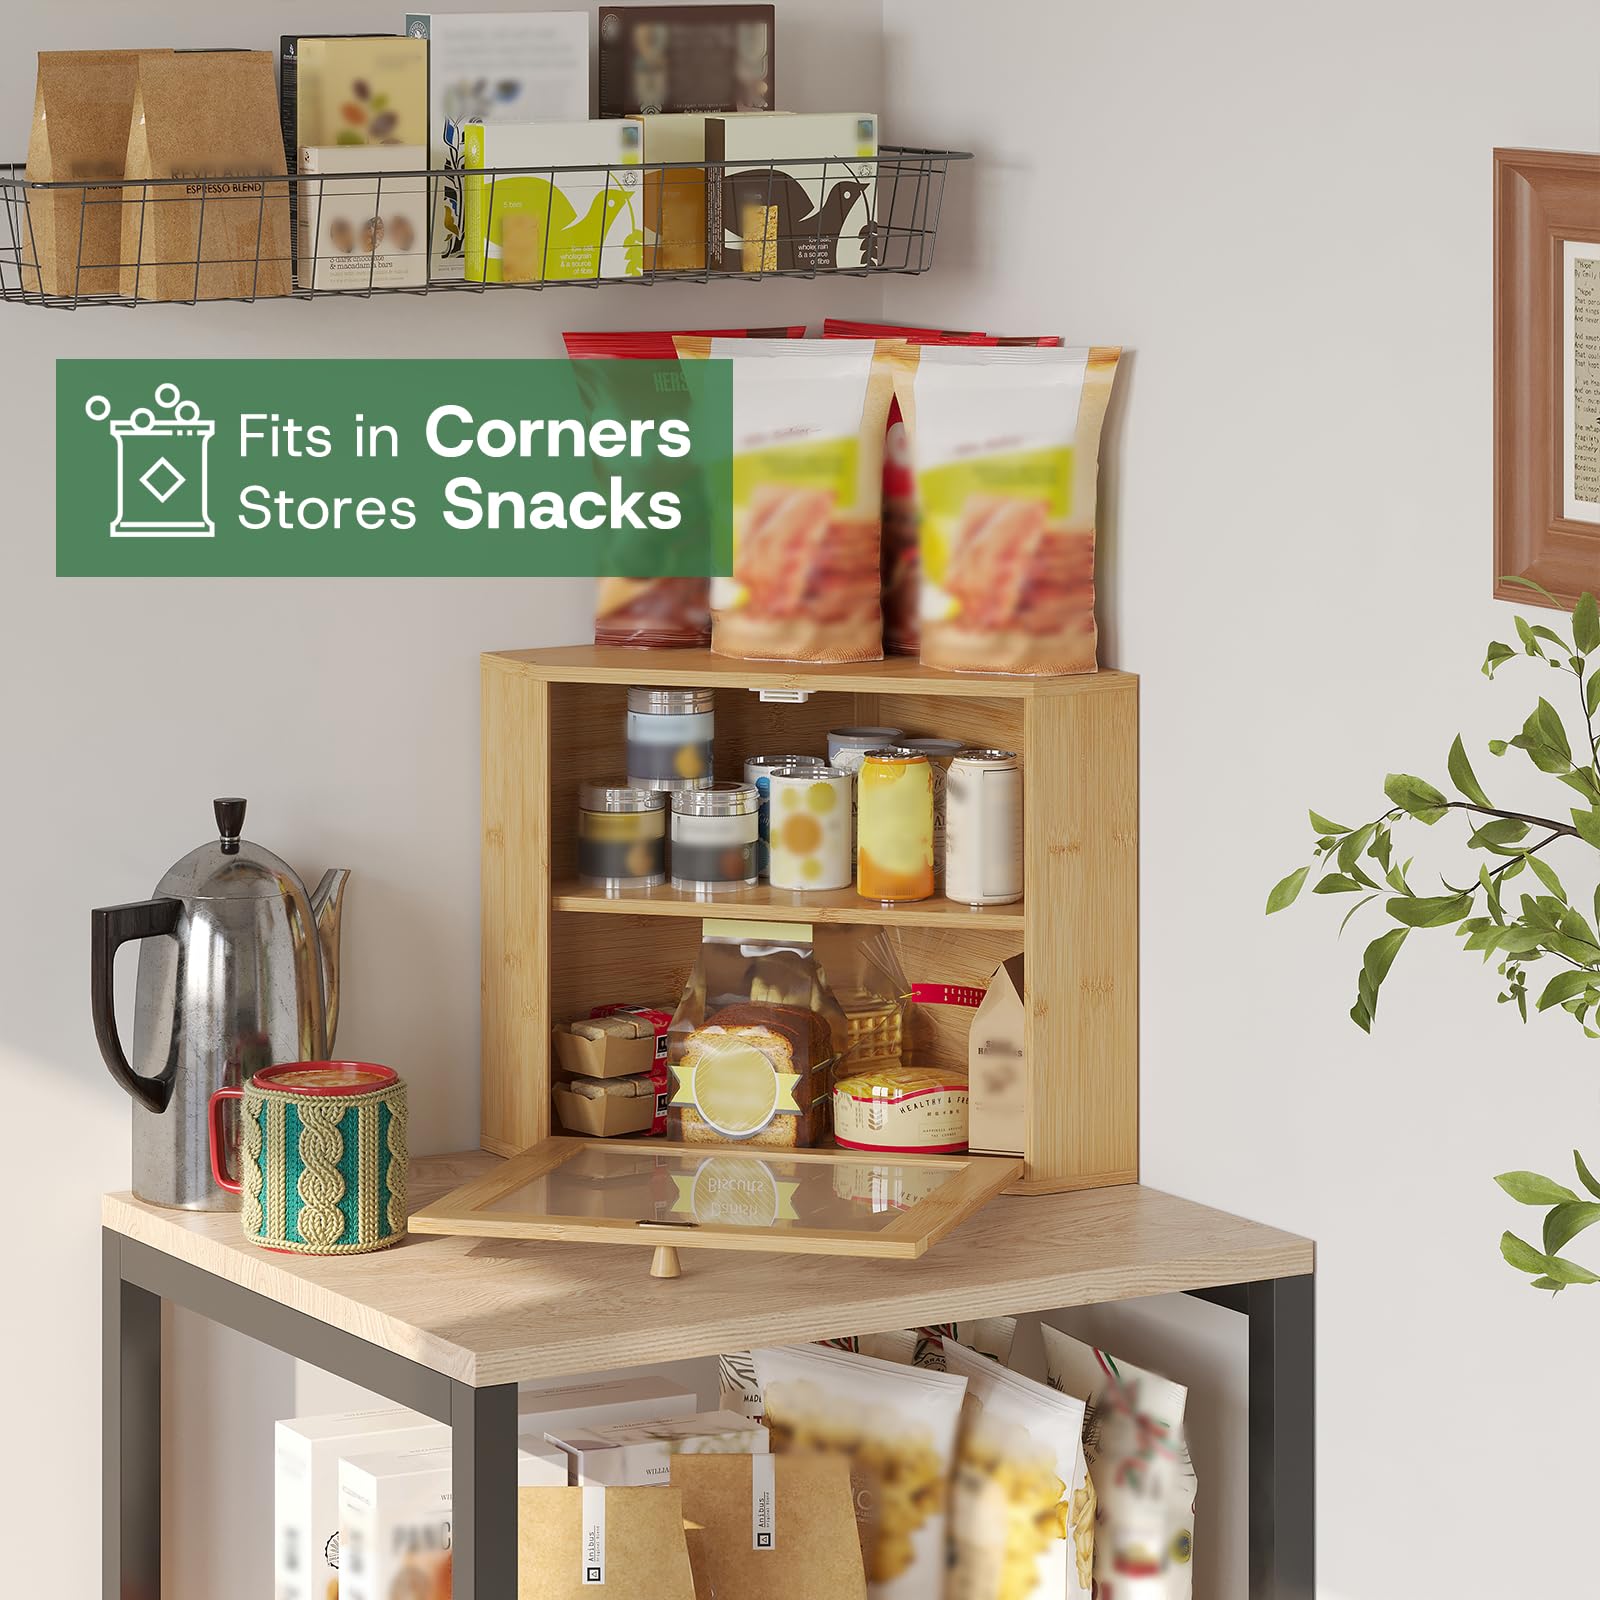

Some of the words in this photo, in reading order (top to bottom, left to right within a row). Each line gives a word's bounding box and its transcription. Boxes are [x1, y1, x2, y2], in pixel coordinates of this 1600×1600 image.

[186, 183, 230, 194] ESPRESSO
[232, 182, 262, 193] BLEND
[899, 1097, 941, 1114] HEALTHY
[947, 1096, 953, 1104] &
